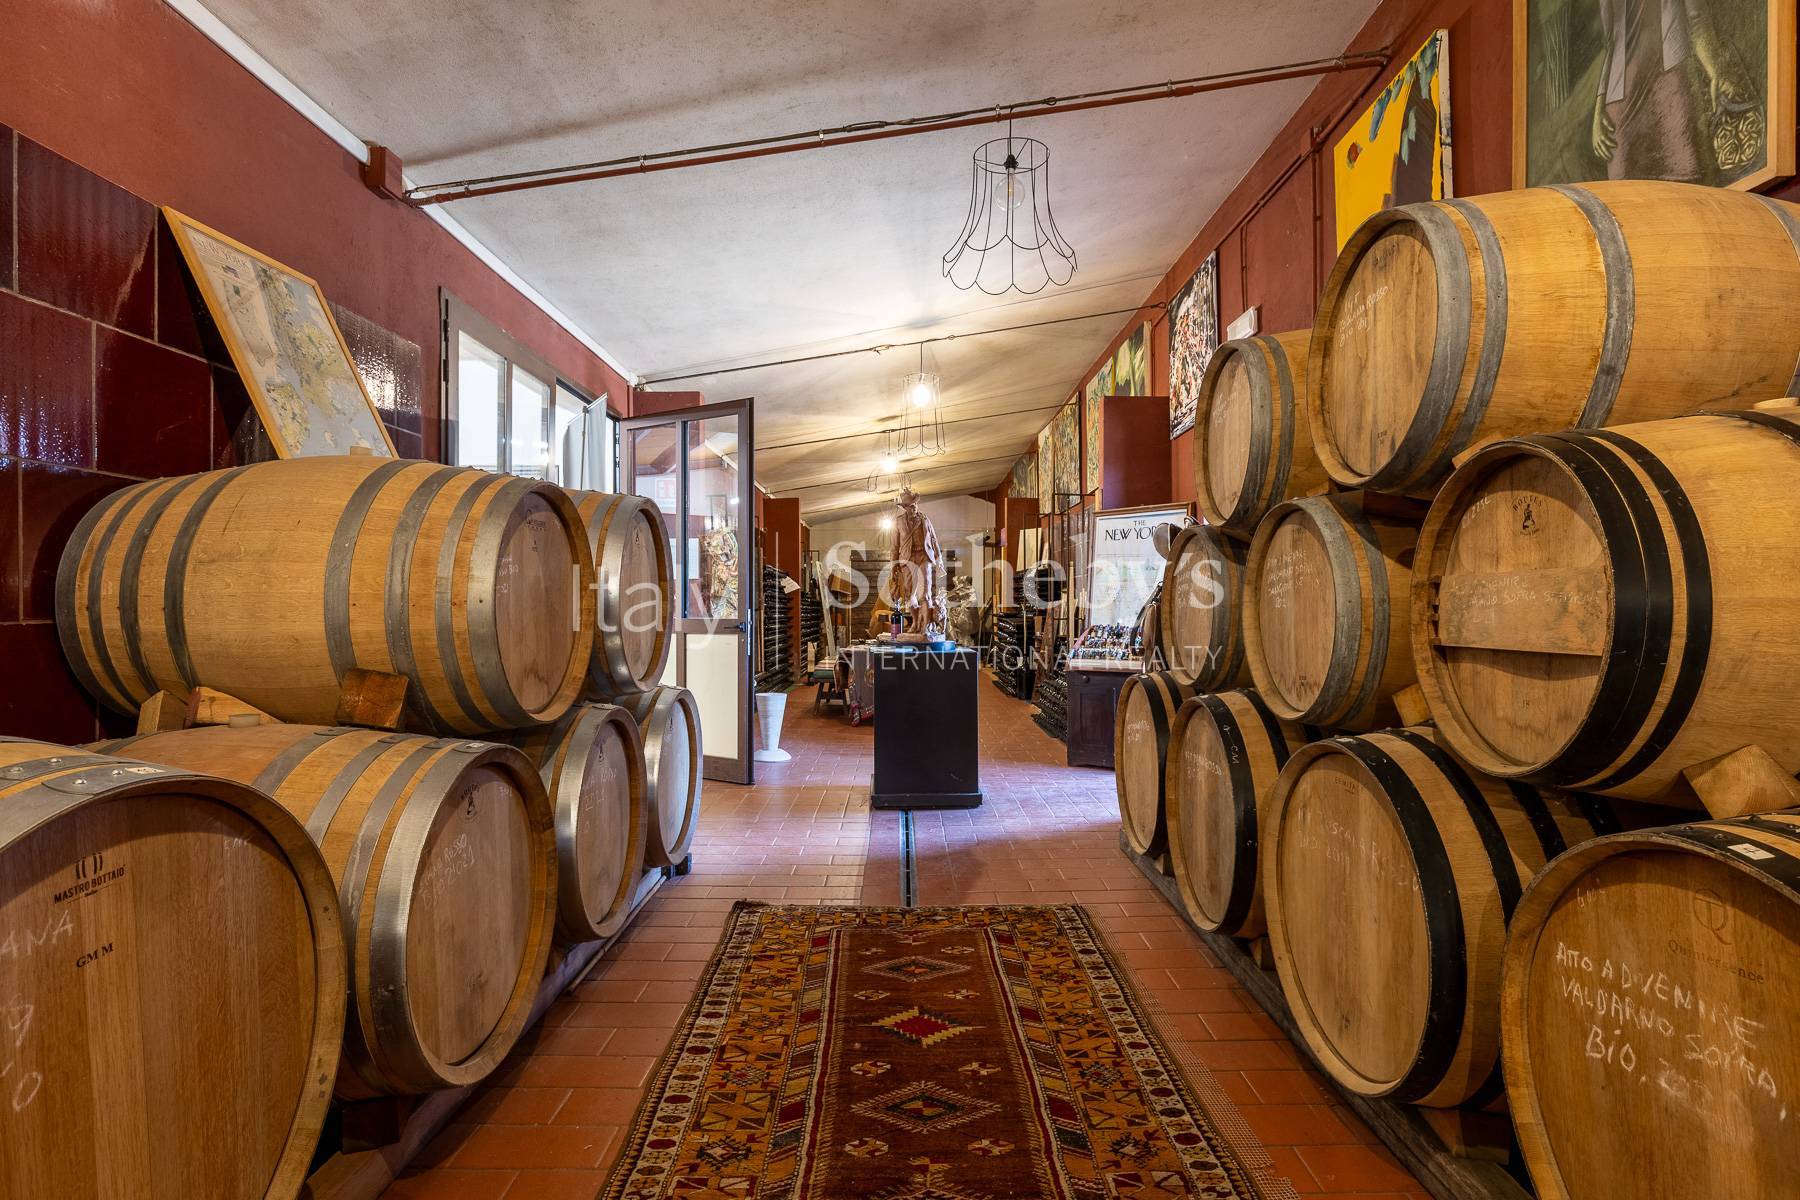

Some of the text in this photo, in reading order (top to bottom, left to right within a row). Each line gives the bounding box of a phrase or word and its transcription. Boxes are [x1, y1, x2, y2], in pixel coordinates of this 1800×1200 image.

[1105, 528, 1132, 541] NEW
[1133, 519, 1146, 527] THE
[54, 866, 125, 904] MASTRO BOTTAIO
[1556, 941, 1593, 972] ATTO
[1601, 959, 1615, 980] A
